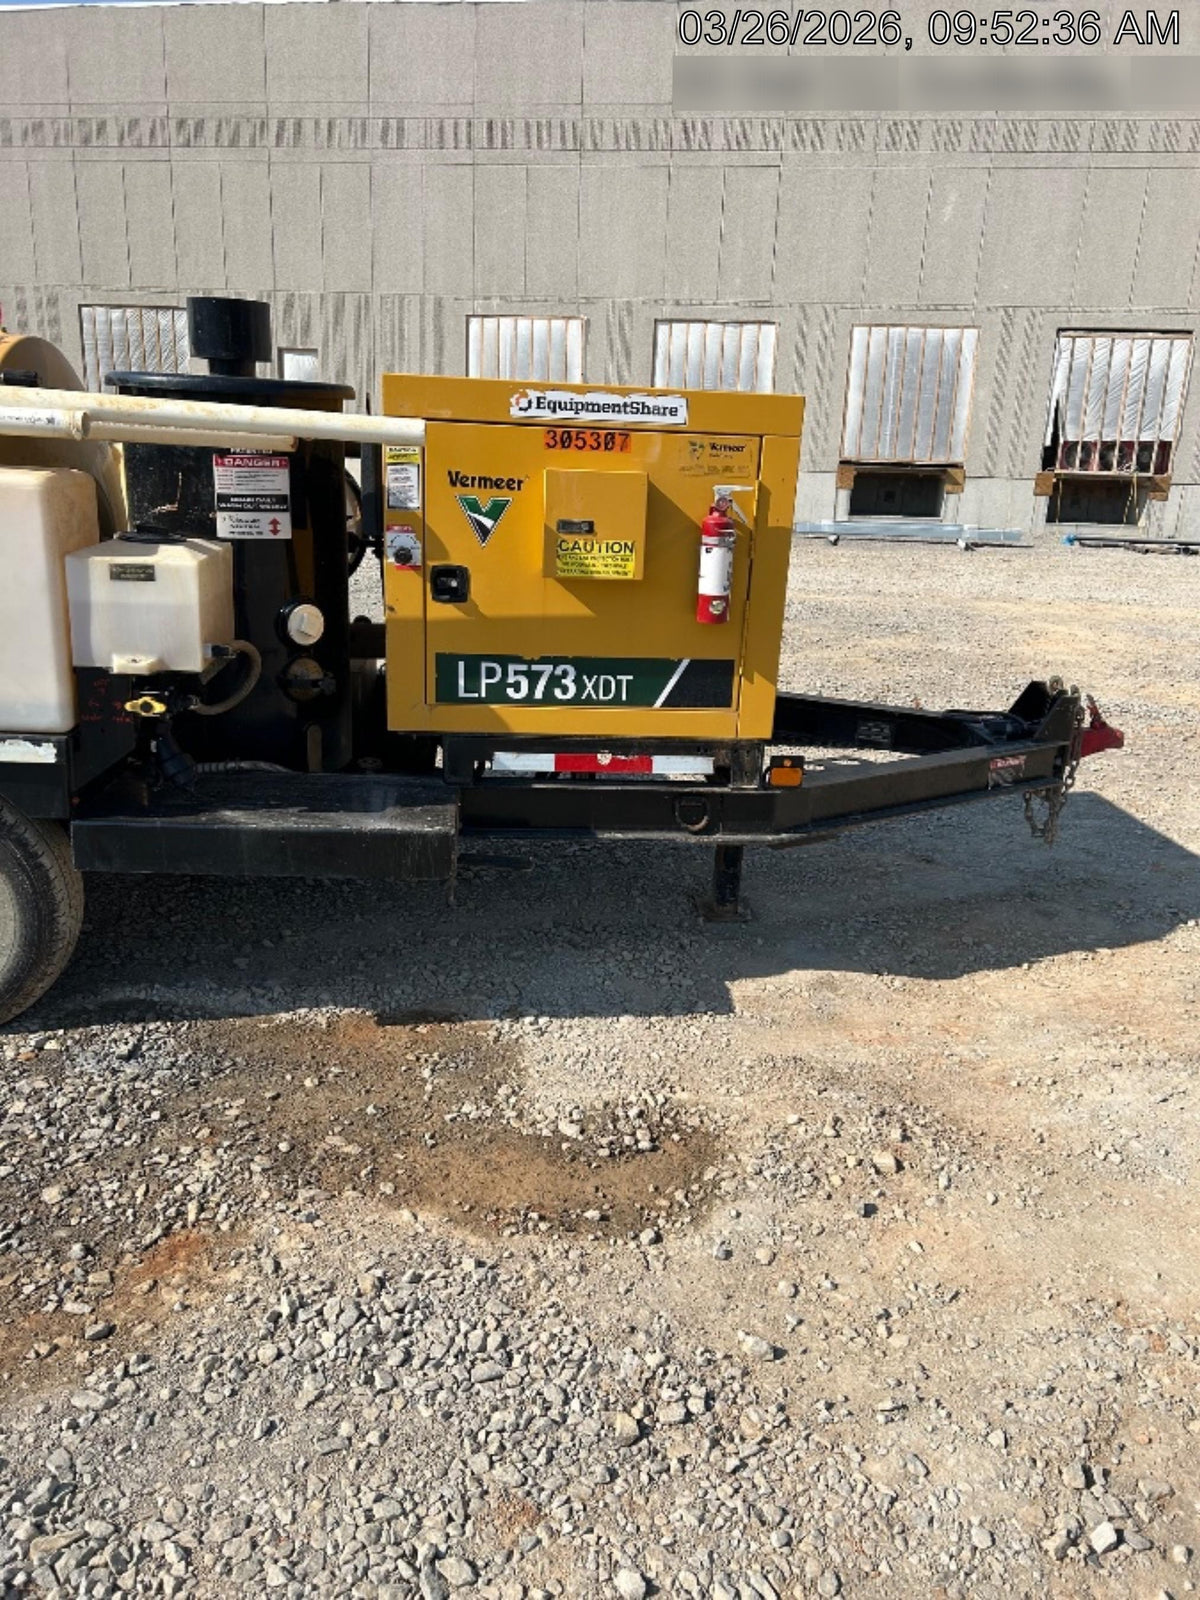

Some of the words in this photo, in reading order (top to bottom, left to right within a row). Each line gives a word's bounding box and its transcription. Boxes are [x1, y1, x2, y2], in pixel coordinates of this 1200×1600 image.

[536, 396, 679, 417] EquipmentShare
[545, 429, 631, 453] 305307
[447, 469, 525, 492] Vermeer
[559, 540, 634, 554] CAUTION
